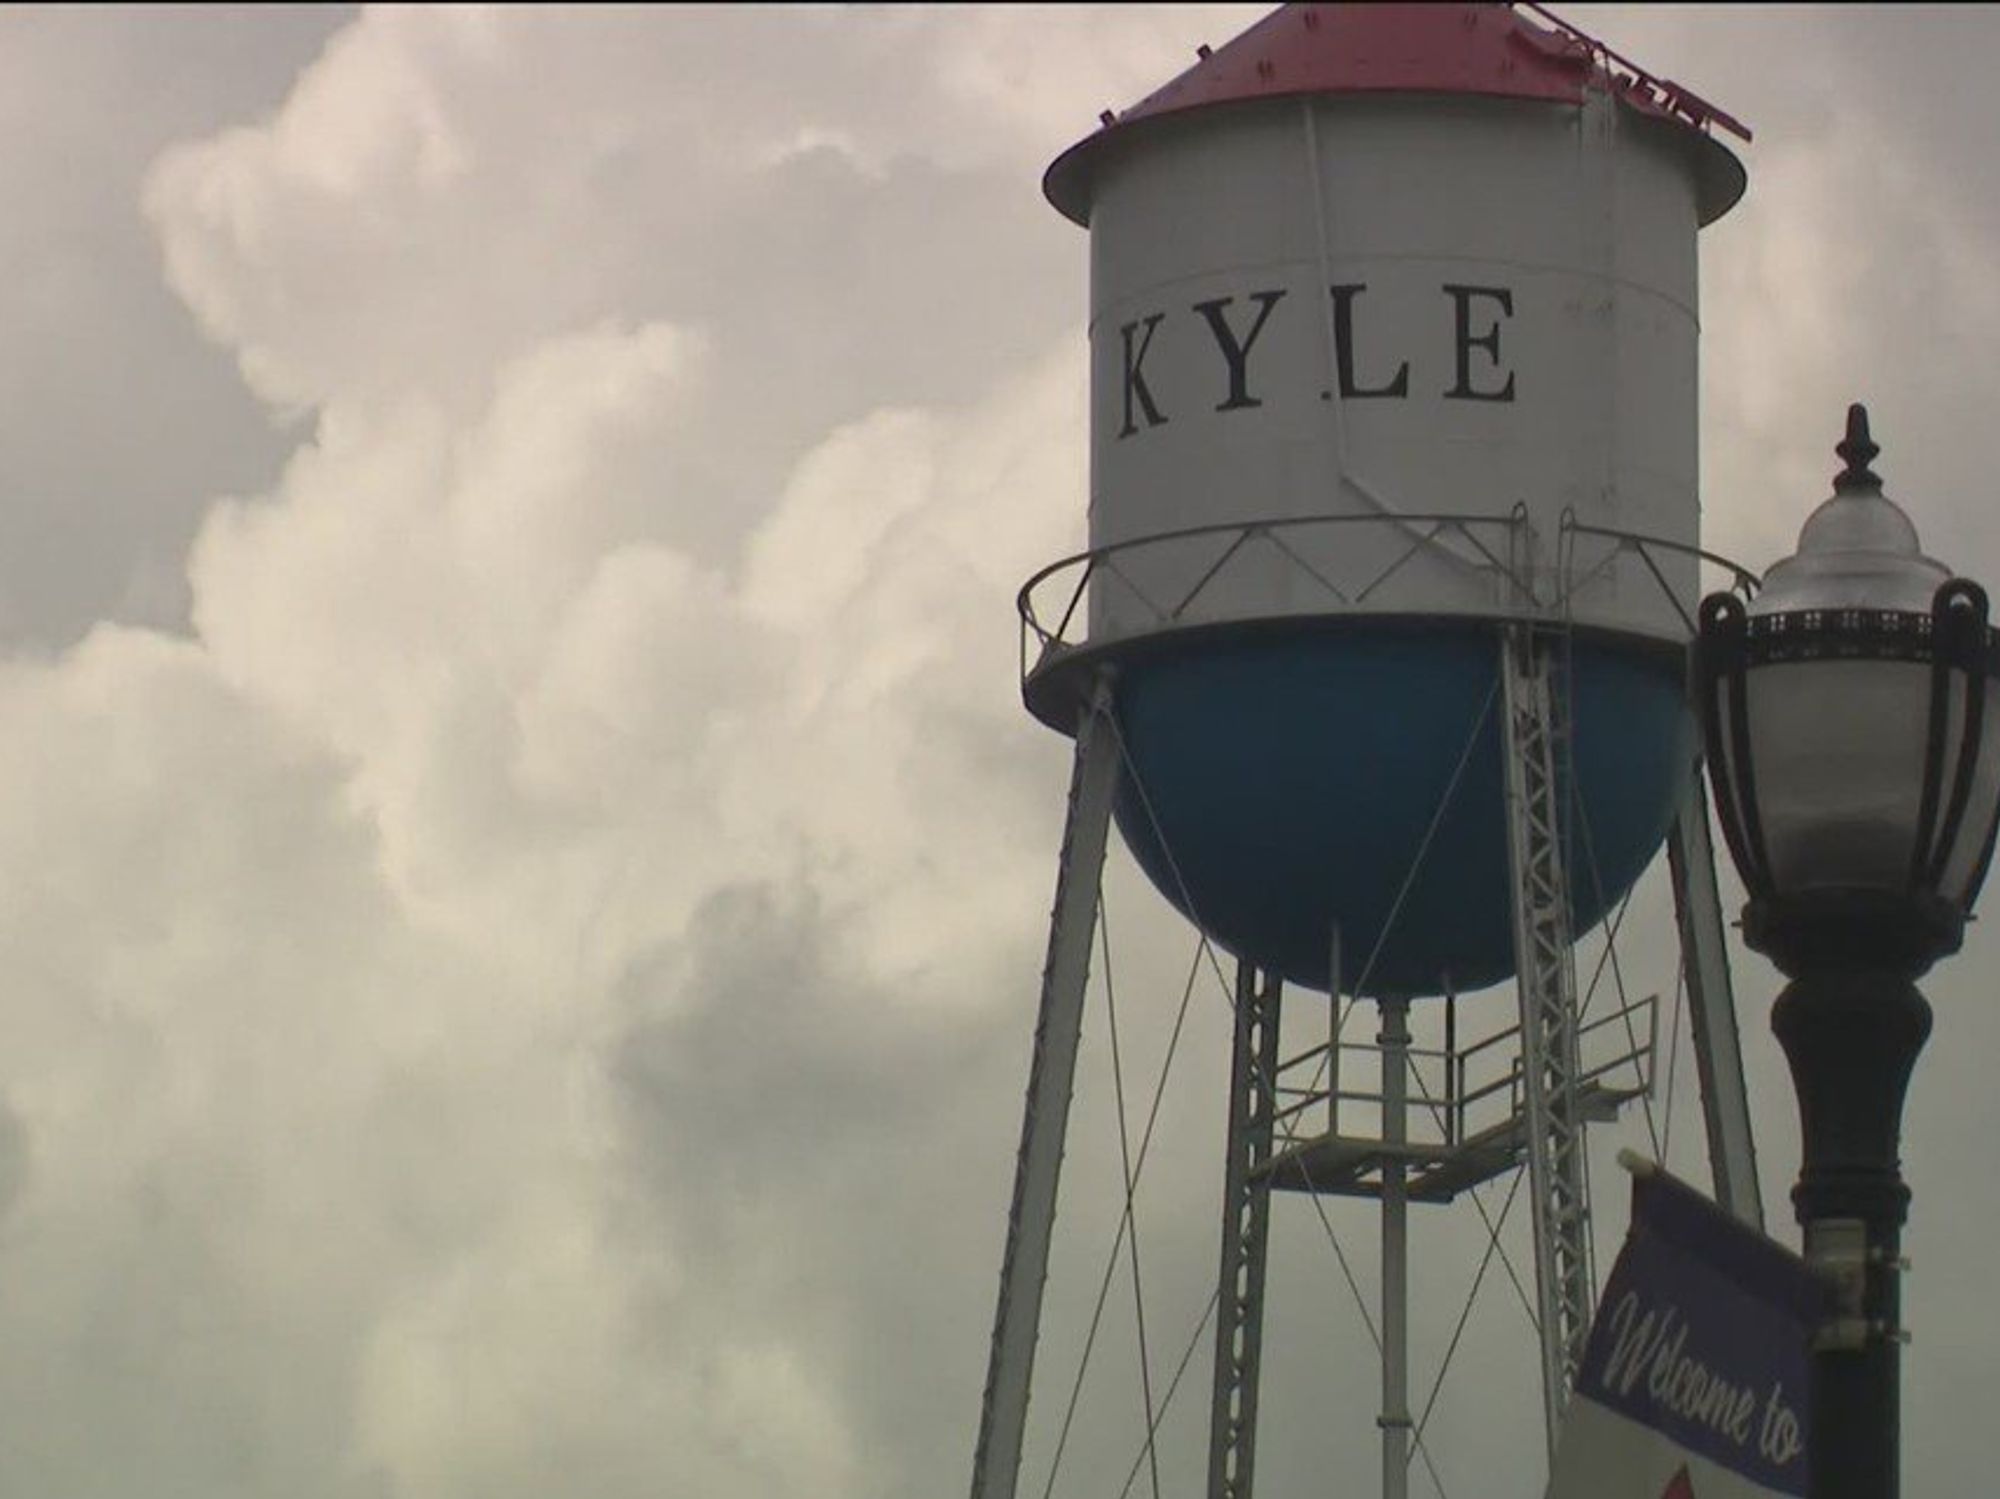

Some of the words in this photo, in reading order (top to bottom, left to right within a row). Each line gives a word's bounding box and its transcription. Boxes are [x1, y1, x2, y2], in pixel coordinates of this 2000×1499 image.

[1118, 283, 1516, 440] KYLE
[1602, 1291, 1757, 1446] Welcome
[1759, 1381, 1803, 1466] to
